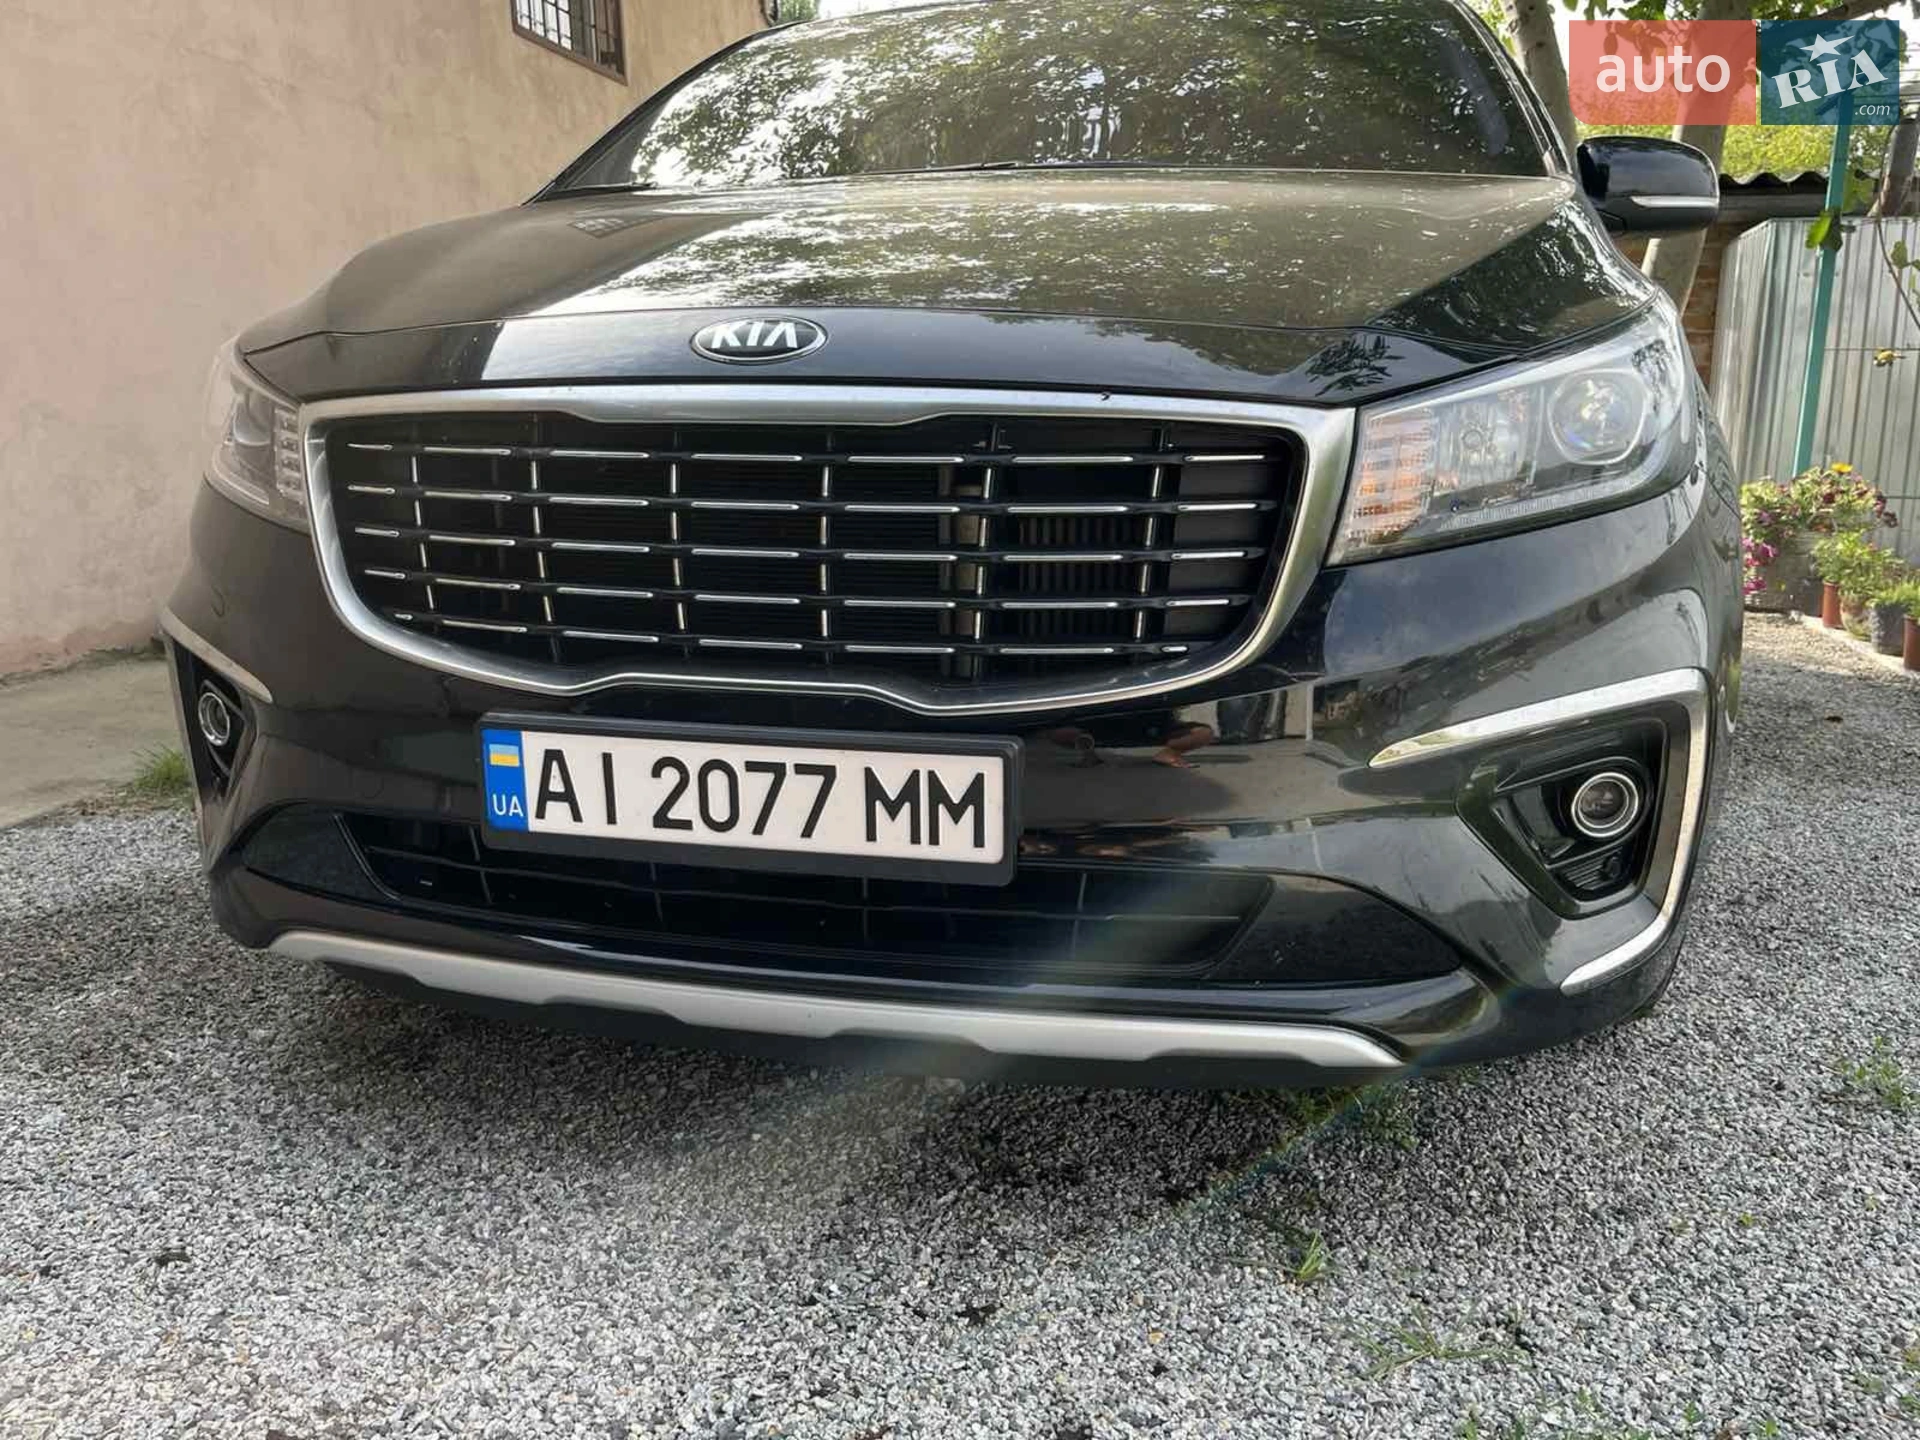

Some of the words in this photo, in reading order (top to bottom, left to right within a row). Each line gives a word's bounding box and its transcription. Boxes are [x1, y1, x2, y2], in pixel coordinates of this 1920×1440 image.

[711, 321, 798, 349] KIA
[493, 793, 524, 817] UA
[535, 748, 617, 825] AI
[650, 756, 837, 838] 2077
[863, 765, 985, 848] MM
